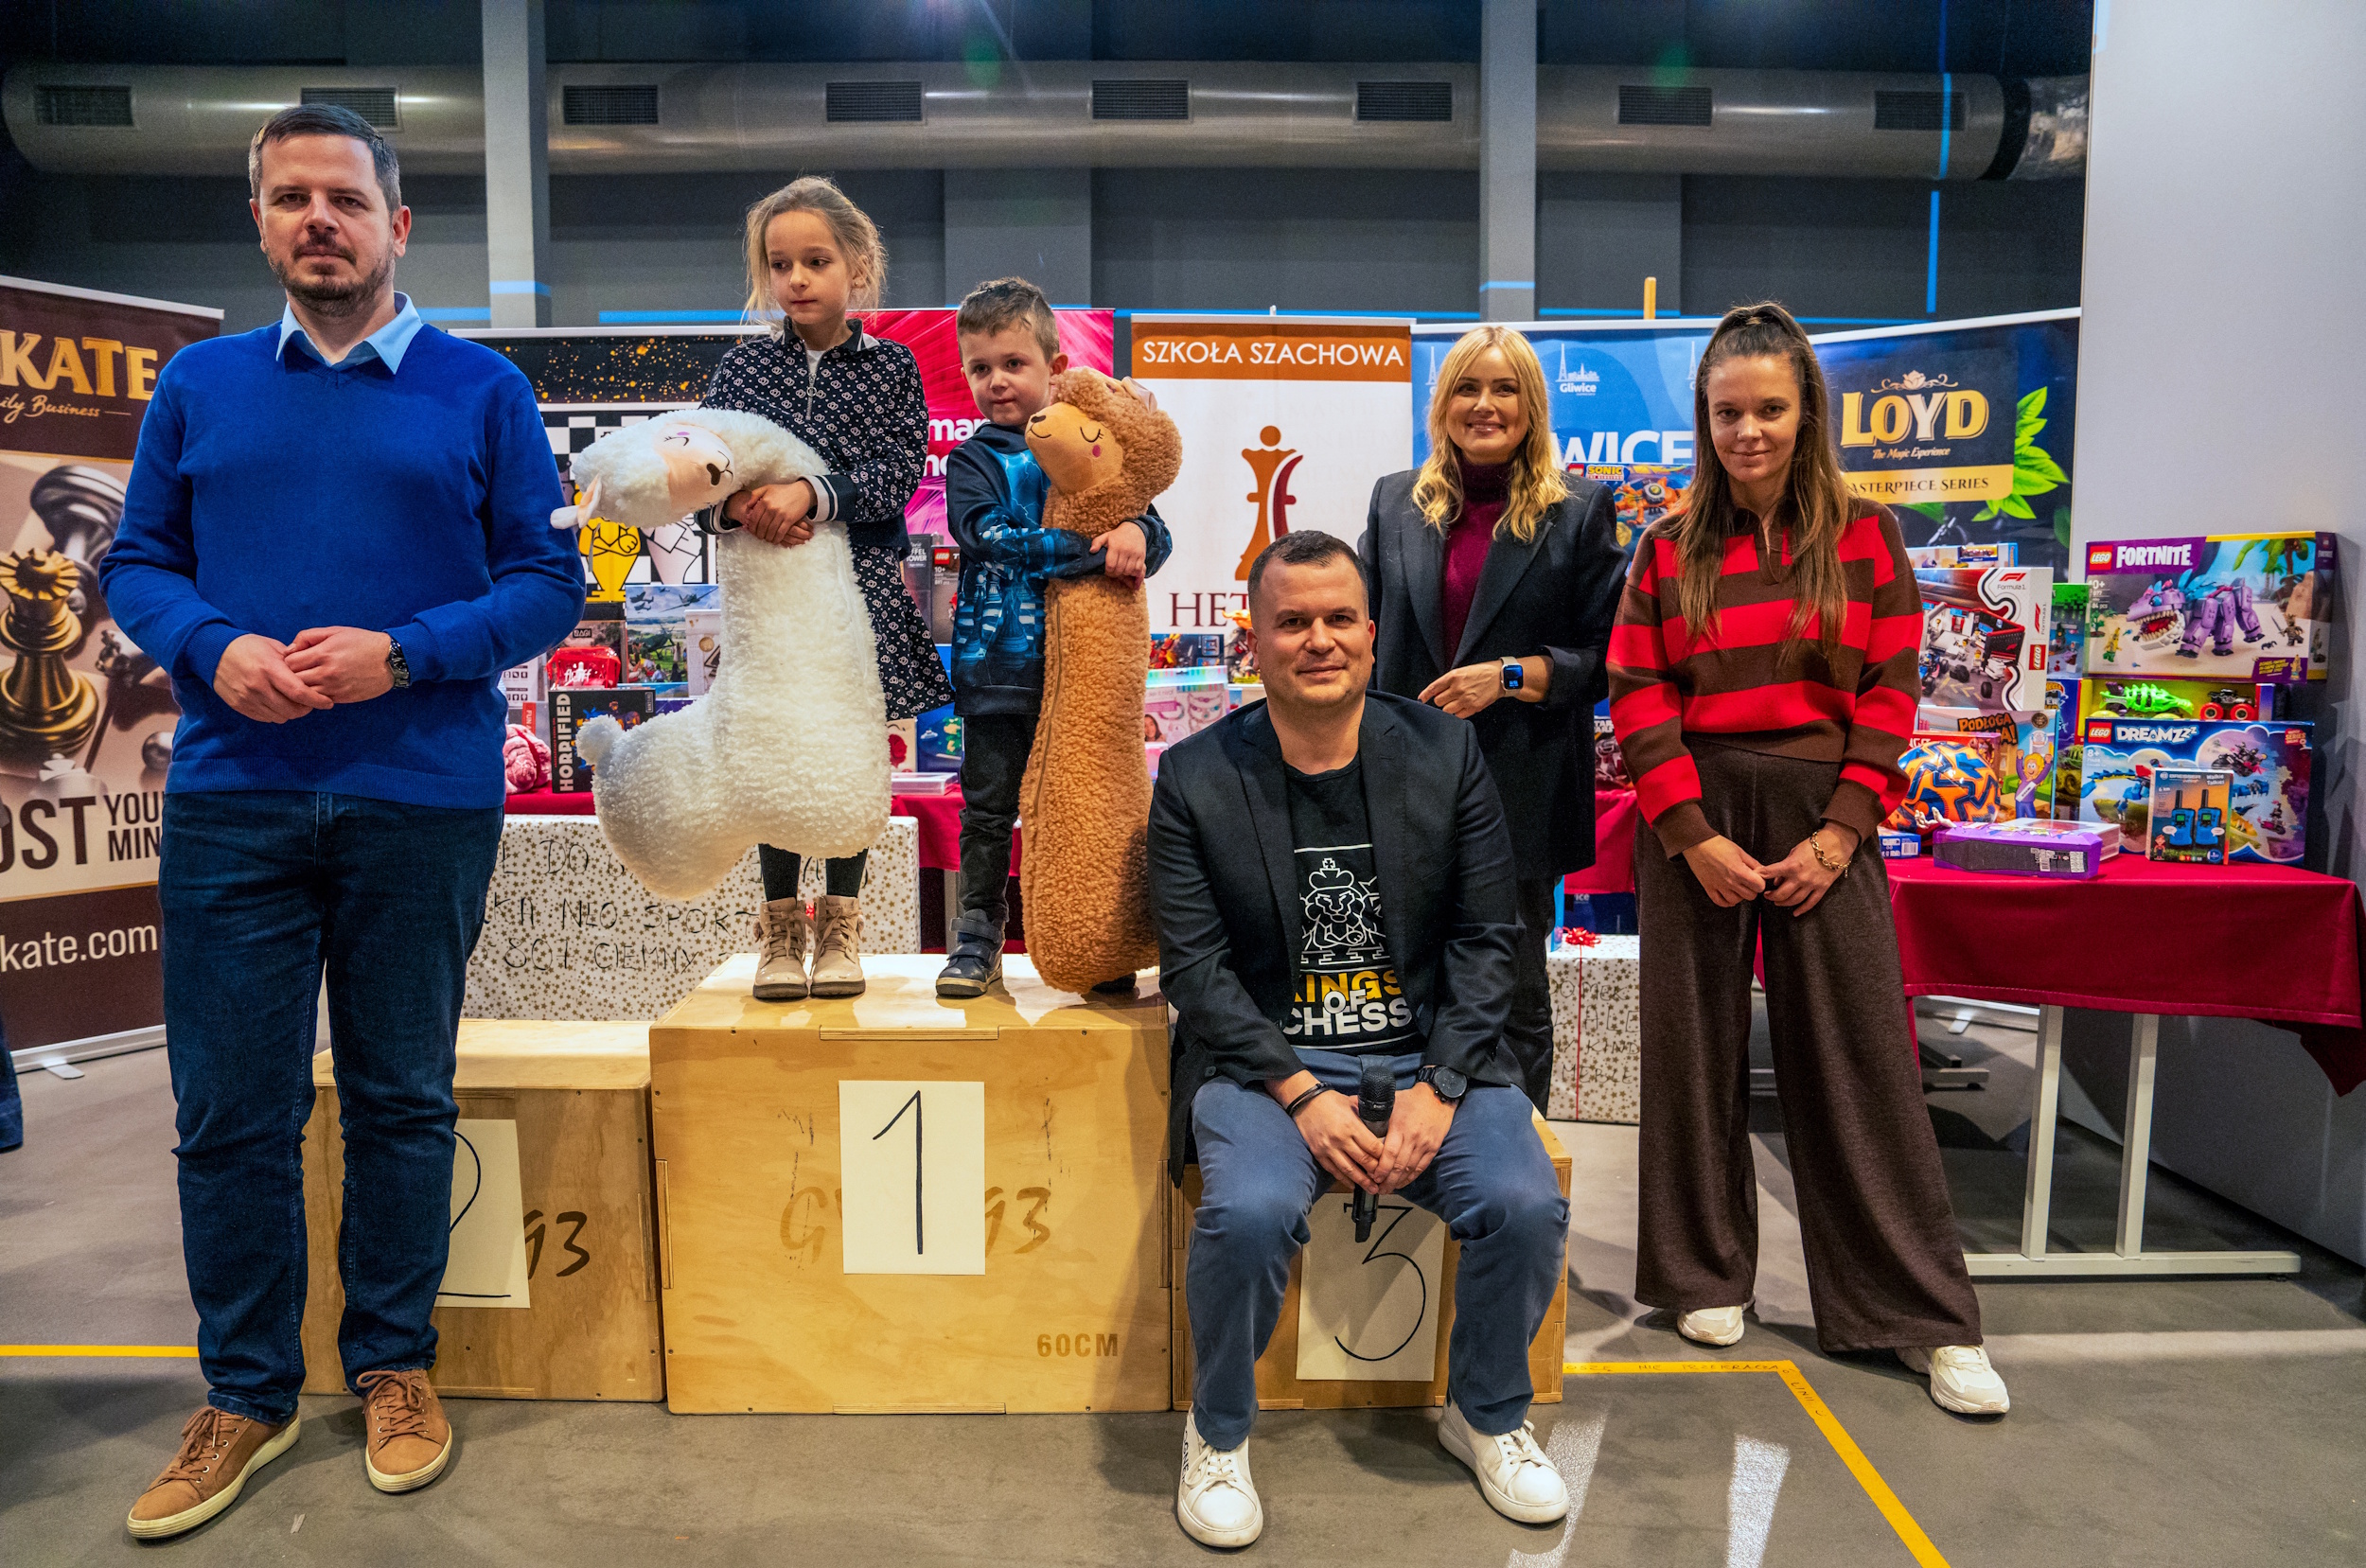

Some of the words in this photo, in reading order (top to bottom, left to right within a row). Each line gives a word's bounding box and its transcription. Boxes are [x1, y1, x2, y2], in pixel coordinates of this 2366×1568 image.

[1142, 341, 1244, 364] SZKOŁA
[1249, 343, 1404, 366] SZACHOWA
[1560, 382, 1597, 394] Gliwice
[24, 394, 100, 417] Business
[1841, 389, 1989, 448] LOYD
[1910, 446, 1951, 460] Experience
[1588, 465, 1622, 475] SONIC
[1941, 476, 1989, 491] SERIES
[2090, 553, 2111, 563] LEGO
[2116, 544, 2192, 569] FORTNITE
[2034, 645, 2042, 670] LEGO
[2090, 729, 2110, 738] LEGO
[2087, 749, 2100, 758] 8+
[103, 791, 165, 826] YOU
[1295, 969, 1403, 1003] INGS
[1324, 988, 1367, 1013] OF
[1282, 996, 1413, 1036] CHESS
[873, 1089, 925, 1255] 1
[1330, 1202, 1426, 1362] 3
[1036, 1333, 1119, 1358] 60CM
